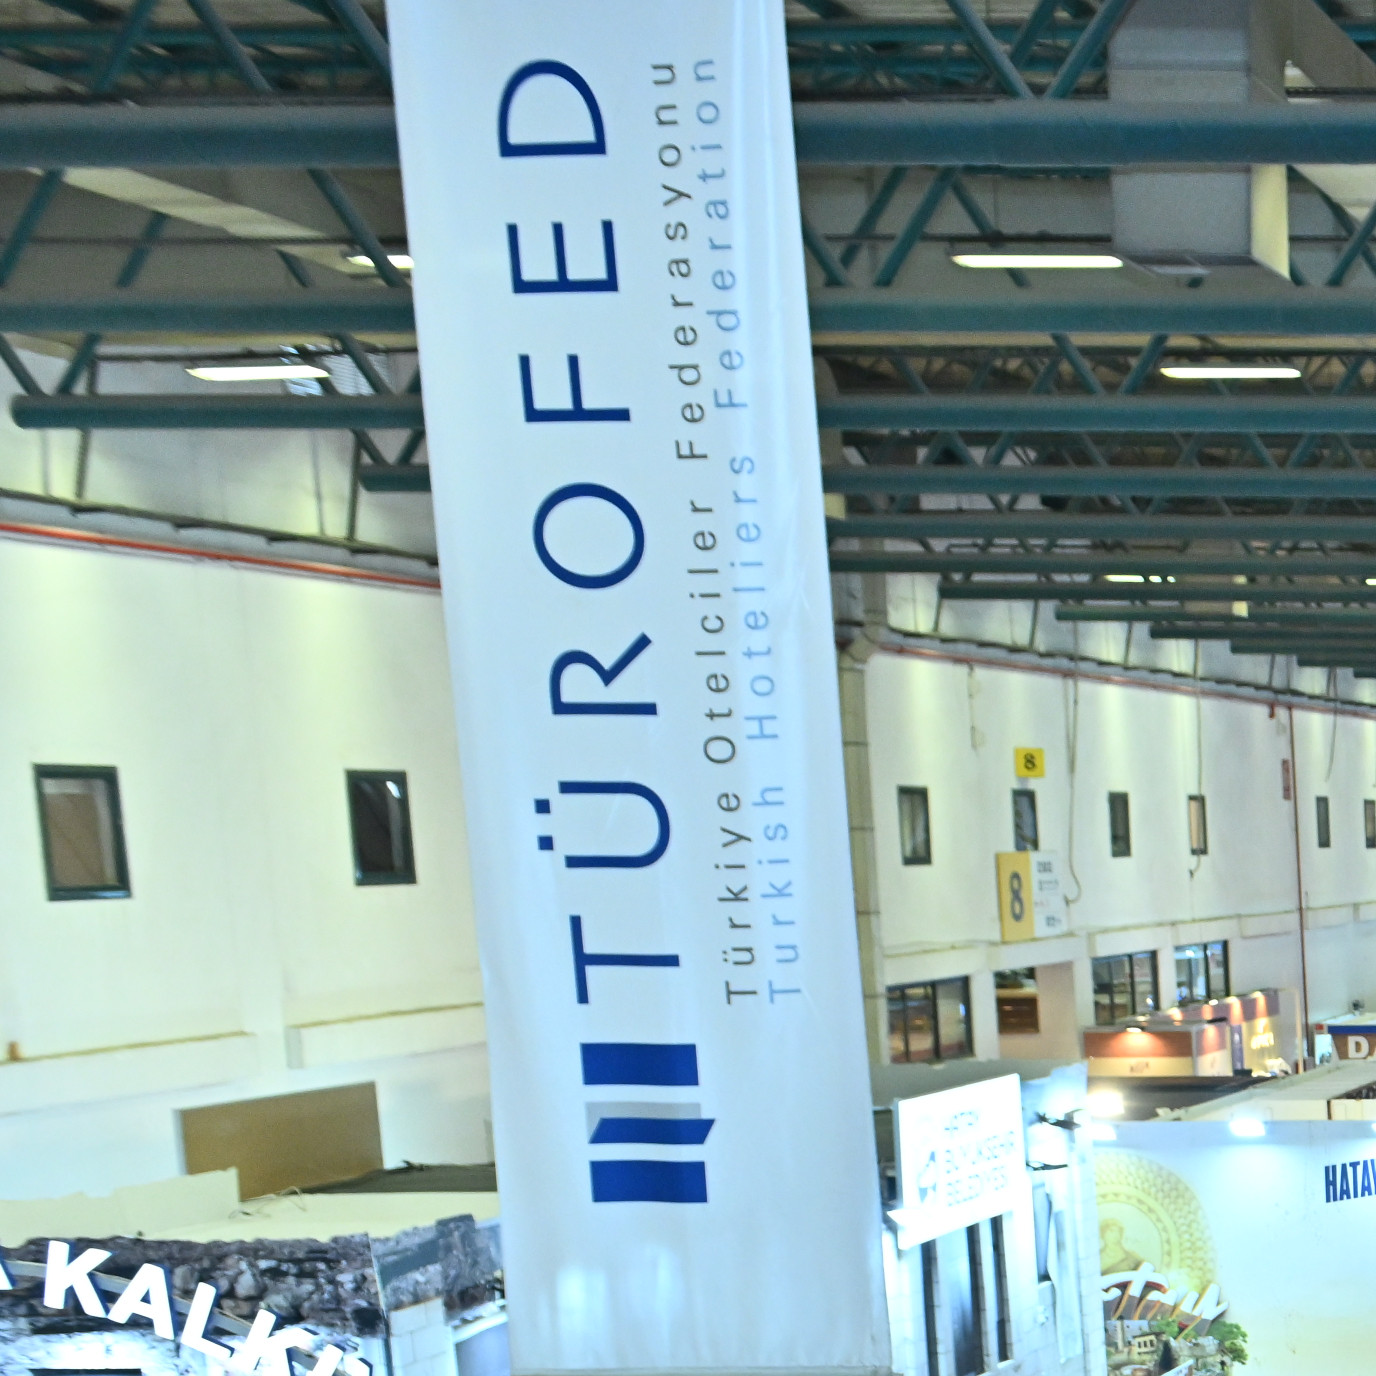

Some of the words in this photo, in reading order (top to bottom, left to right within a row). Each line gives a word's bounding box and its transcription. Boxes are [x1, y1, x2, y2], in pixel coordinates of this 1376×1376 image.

[651, 61, 709, 459] Federasyonu
[692, 58, 748, 410] Federation
[497, 58, 680, 1005] TÜROFED
[687, 497, 738, 764] Otelciler
[728, 454, 779, 740] Hoteliers
[751, 783, 802, 1004] Turkish
[1024, 753, 1036, 770] 8
[715, 789, 757, 1005] Türkiye
[1009, 872, 1024, 922] 8
